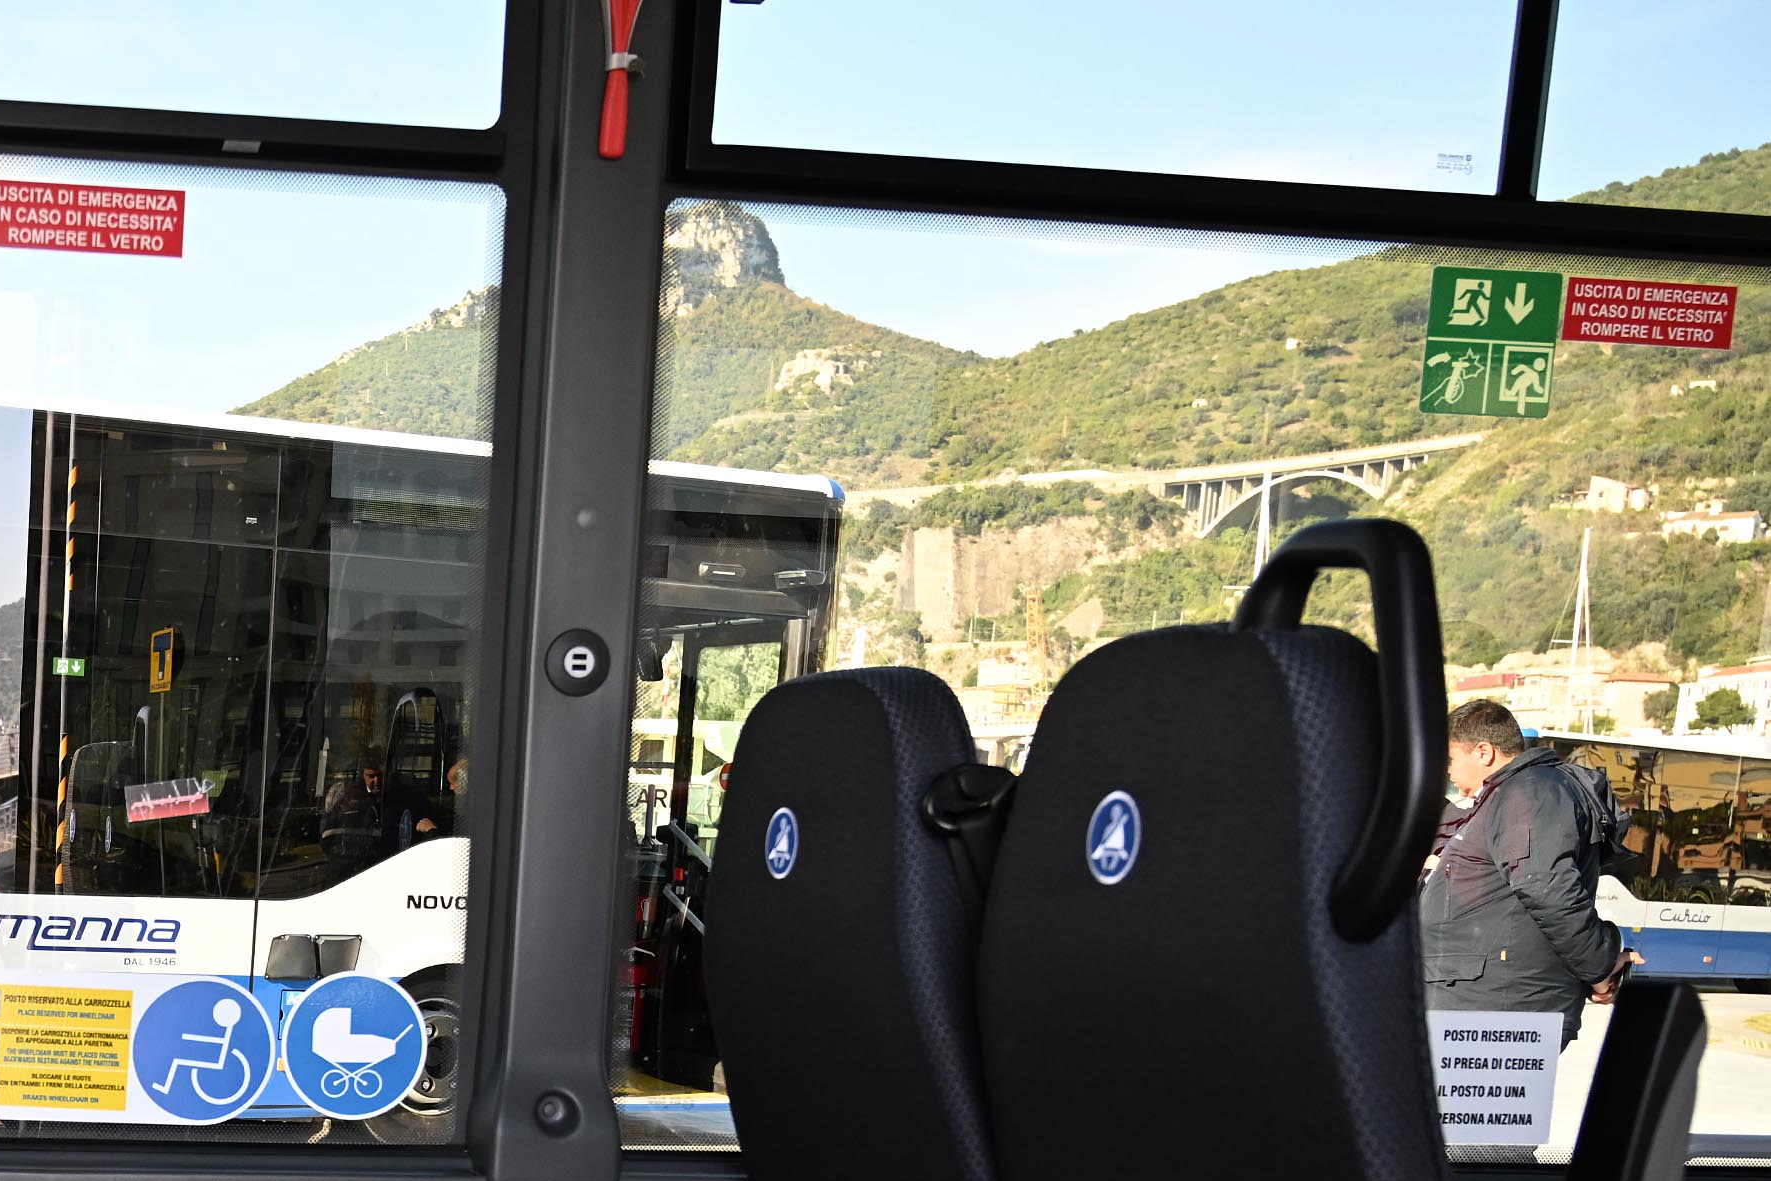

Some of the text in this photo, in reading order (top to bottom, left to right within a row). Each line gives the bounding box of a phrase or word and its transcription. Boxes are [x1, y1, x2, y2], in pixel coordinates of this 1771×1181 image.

[58, 189, 73, 205] DI
[78, 190, 178, 212] EMERGENZA
[15, 207, 61, 225] CASO
[65, 210, 82, 226] DI
[85, 211, 177, 232] NECESSITA'
[8, 227, 164, 251] ROMPERE IL VETRO
[1574, 283, 1729, 306] USCITA DI EMERGENZA
[1571, 302, 1728, 325] IN CASO DI NECESSITA'
[1580, 322, 1714, 343] ROMPERE IL VETRO
[1659, 908, 1711, 923] Curcio
[123, 957, 176, 966] DAL 1946
[4, 994, 131, 1008] POSTO RISERVATO ALLA CARROZZELLA
[1444, 1029, 1541, 1043] POSTO RISERVATO:
[1441, 1057, 1545, 1070] SI PREGA DI CEDERE
[84, 1083, 125, 1091] CARROZZELLA
[1438, 1085, 1526, 1098] IL POSTO AD UNA
[1487, 1113, 1532, 1125] ANZIANA
